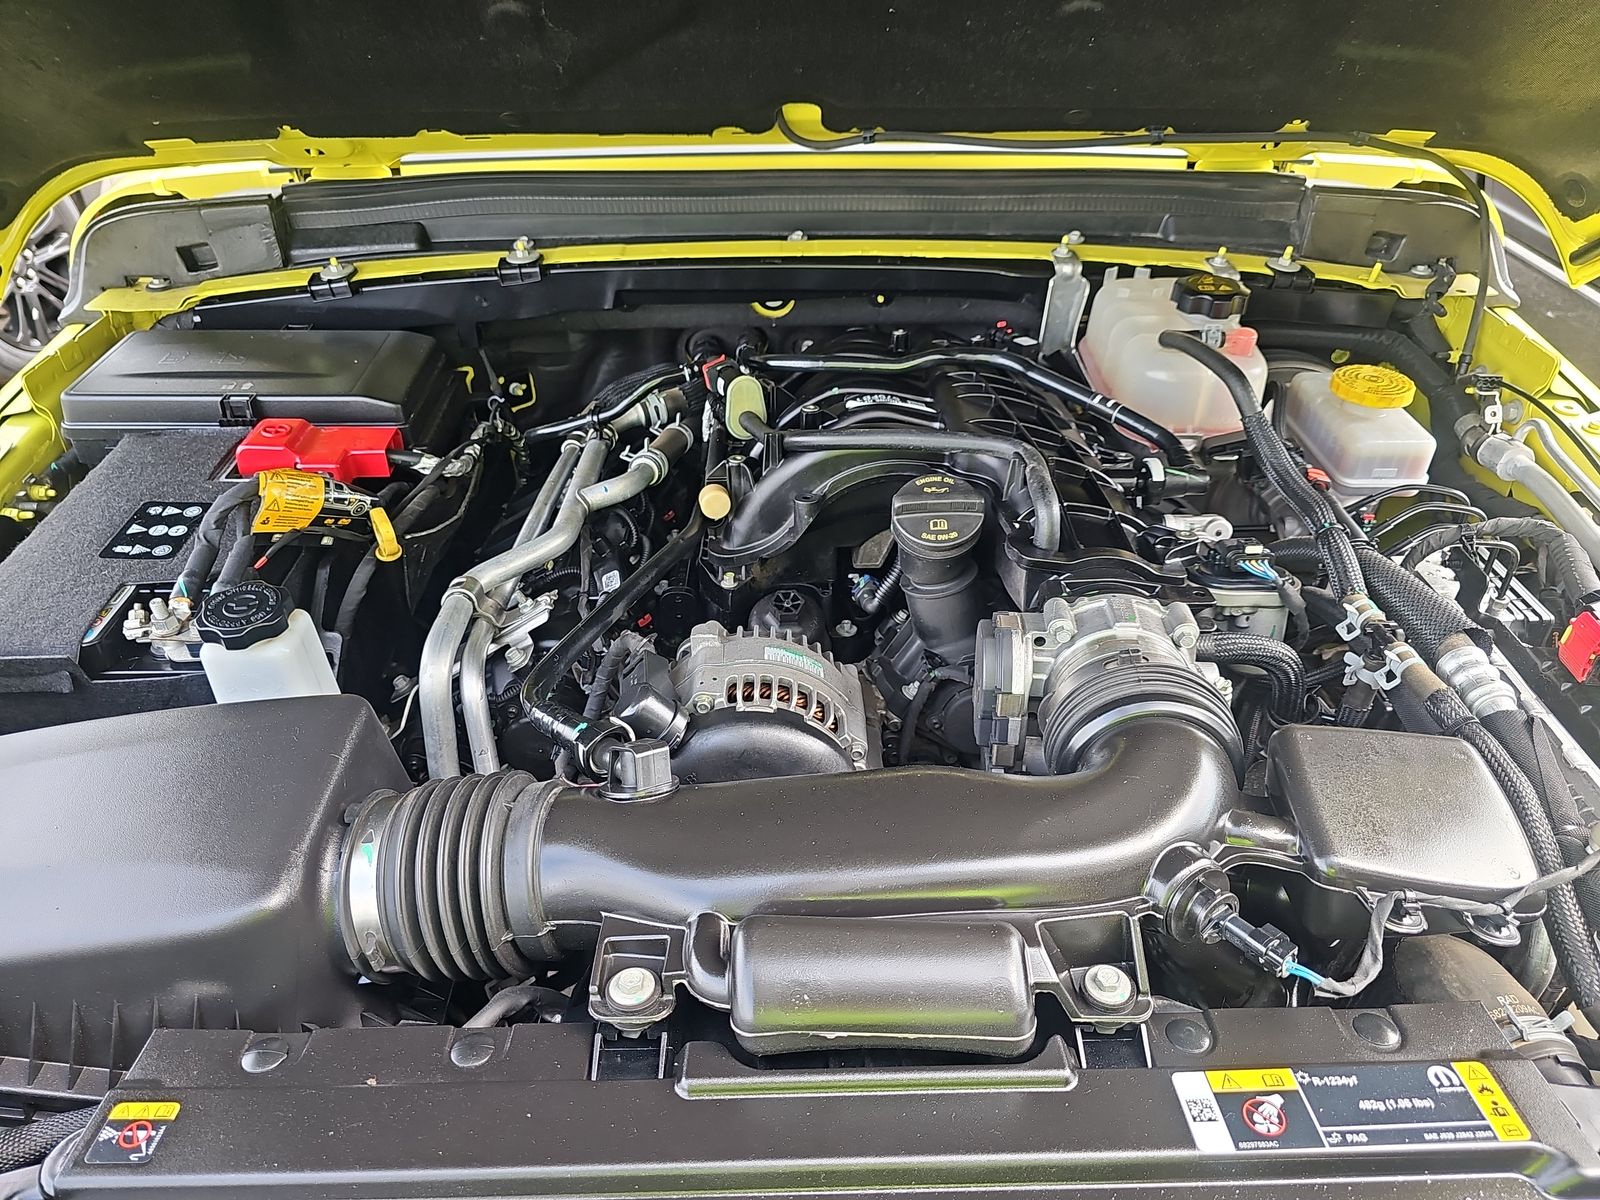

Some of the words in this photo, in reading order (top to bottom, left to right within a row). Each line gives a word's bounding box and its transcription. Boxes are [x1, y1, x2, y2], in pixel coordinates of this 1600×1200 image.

[916, 476, 942, 485] ENGINE
[943, 477, 954, 485] OIL
[921, 532, 936, 540] SAE
[1496, 994, 1519, 1006] RAD
[1311, 1075, 1359, 1087] R-1234yf
[1412, 1097, 1435, 1112] lbs)
[1345, 1133, 1368, 1143] PAG
